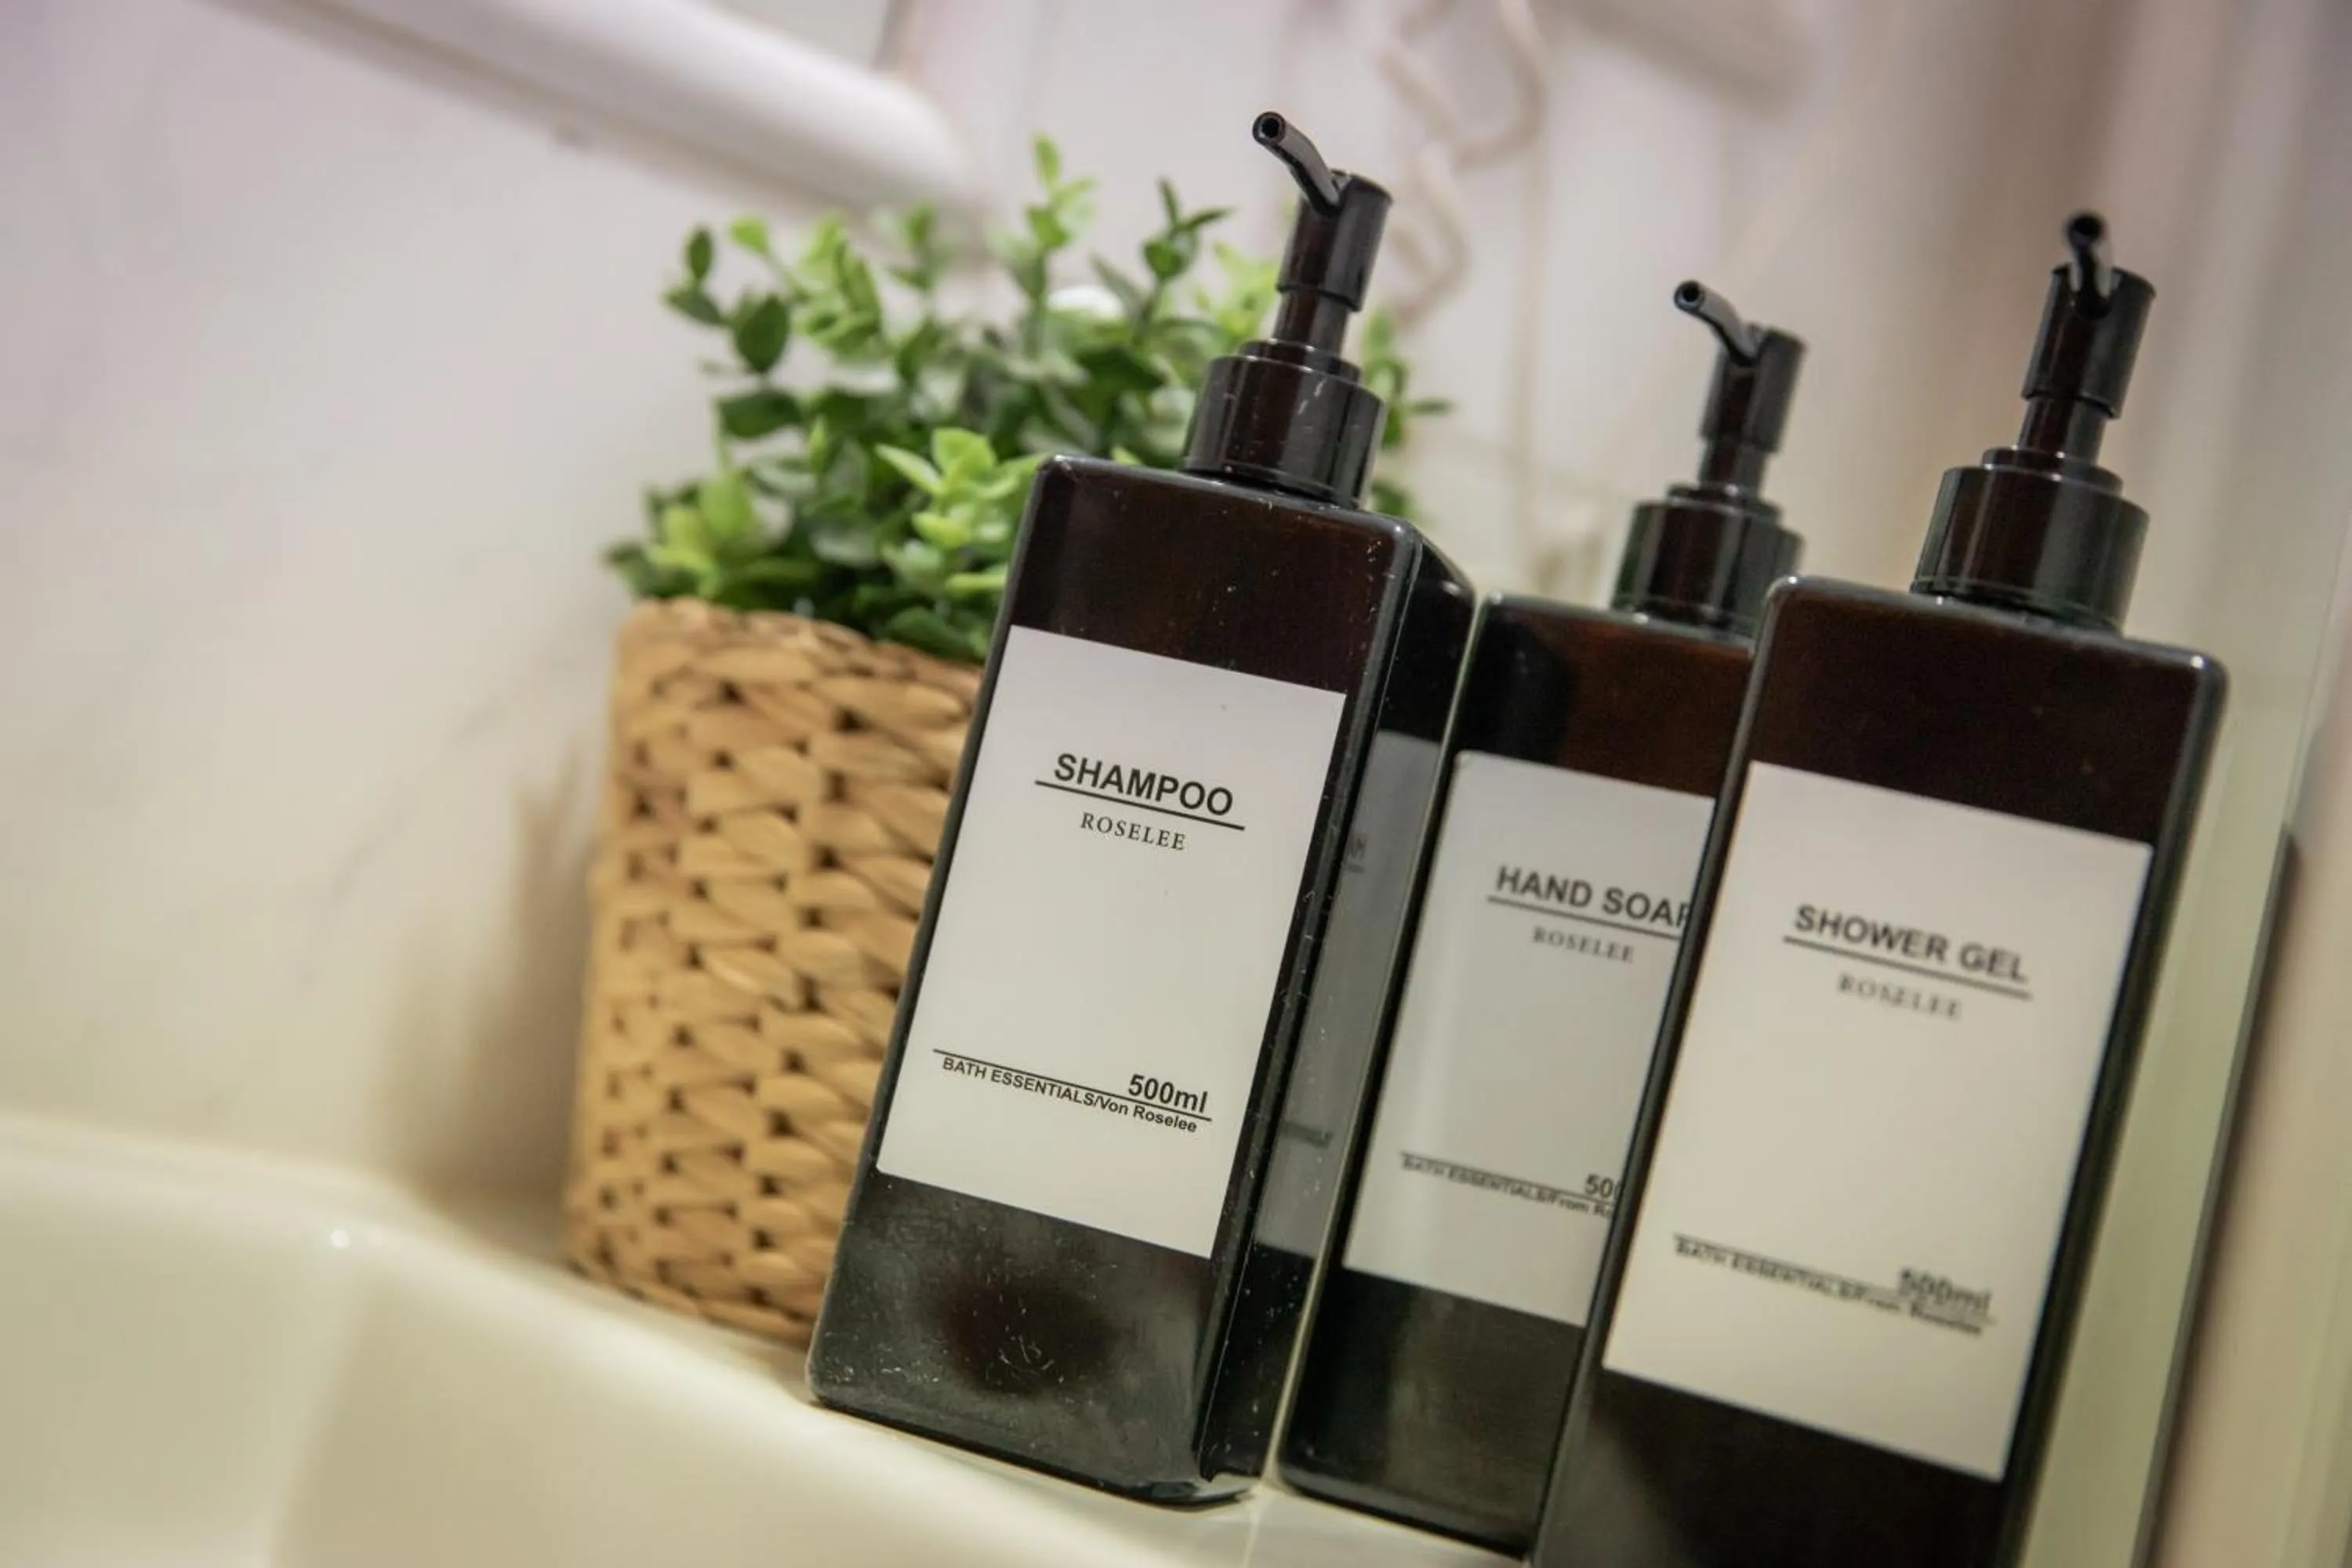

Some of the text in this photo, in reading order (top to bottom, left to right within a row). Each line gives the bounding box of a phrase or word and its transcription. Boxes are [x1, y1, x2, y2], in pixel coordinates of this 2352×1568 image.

[1054, 753, 1233, 816] SHAMPOO
[1079, 811, 1186, 851] ROSELEE
[1496, 865, 1594, 909] HAND
[1532, 925, 1635, 964] ROSELEE
[1795, 904, 2029, 984] SHOWER GEL
[1838, 974, 1962, 1023] ROSELEE
[942, 1056, 1198, 1133] BATH ESSENTIALS/Von Roselee
[1128, 1073, 1209, 1113] 500ml
[1898, 1266, 1992, 1321] 500ml
